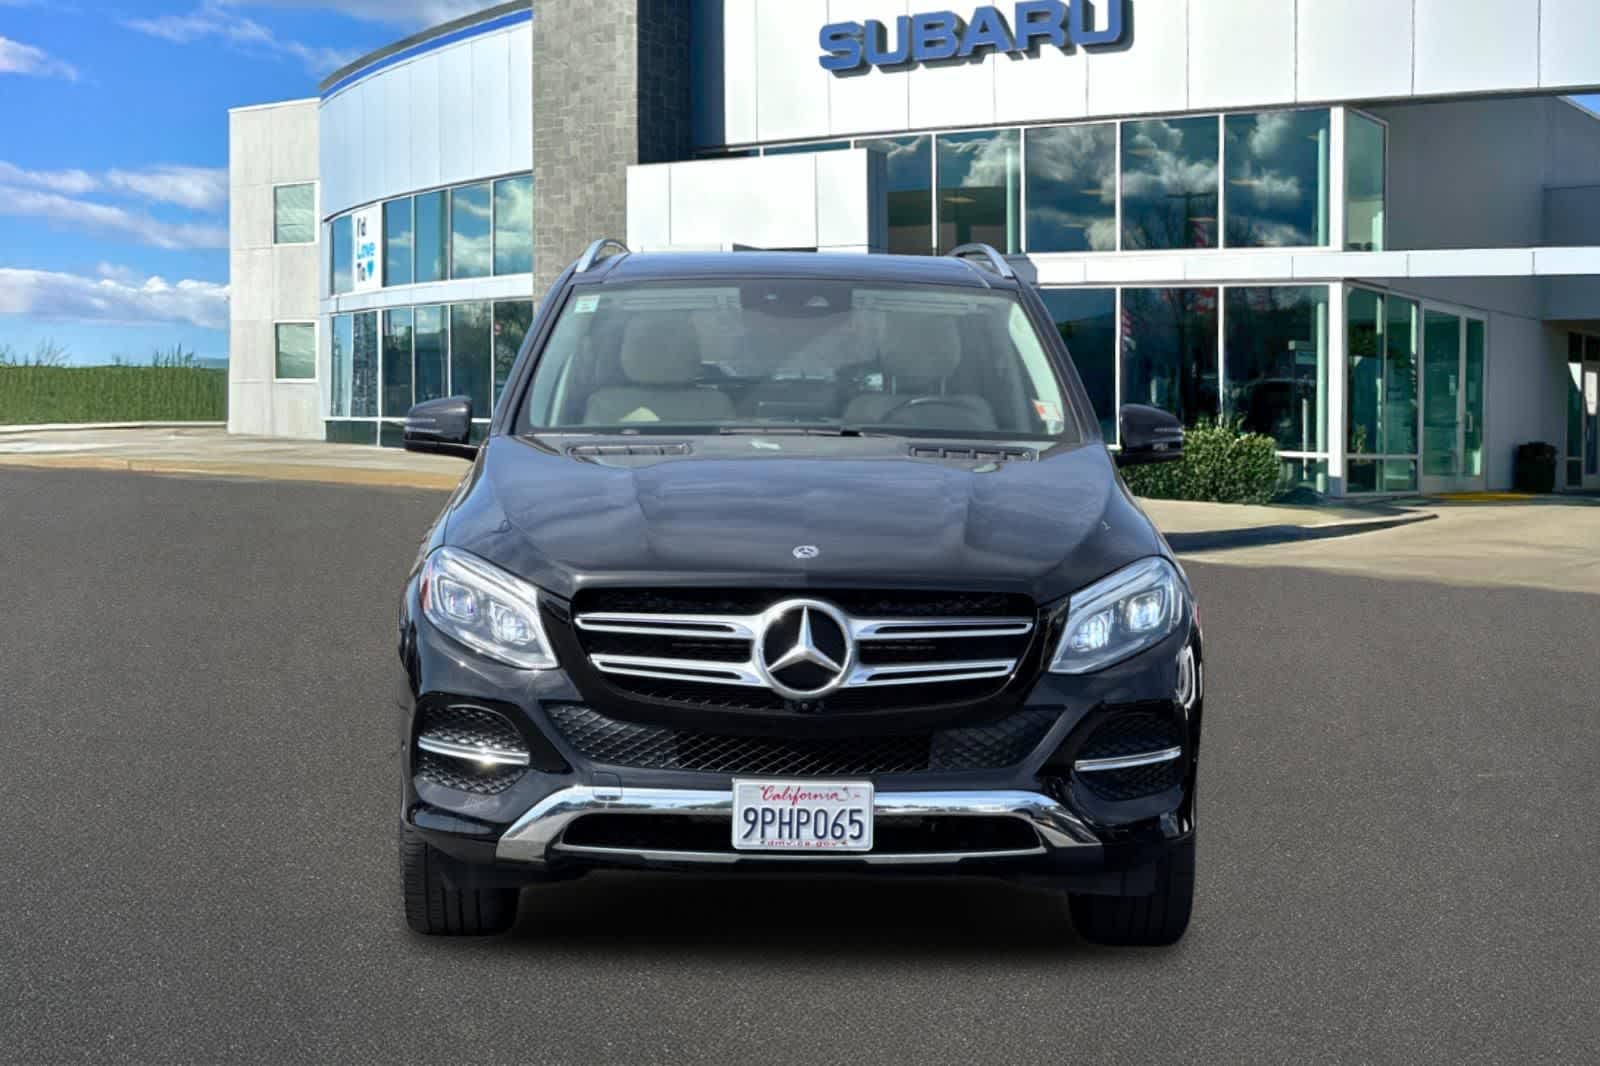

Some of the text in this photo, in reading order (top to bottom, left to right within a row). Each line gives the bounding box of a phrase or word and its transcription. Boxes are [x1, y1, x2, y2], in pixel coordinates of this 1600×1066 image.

[819, 0, 1128, 74] SUBARU
[761, 785, 839, 806] California
[742, 807, 864, 840] 9PHP065
